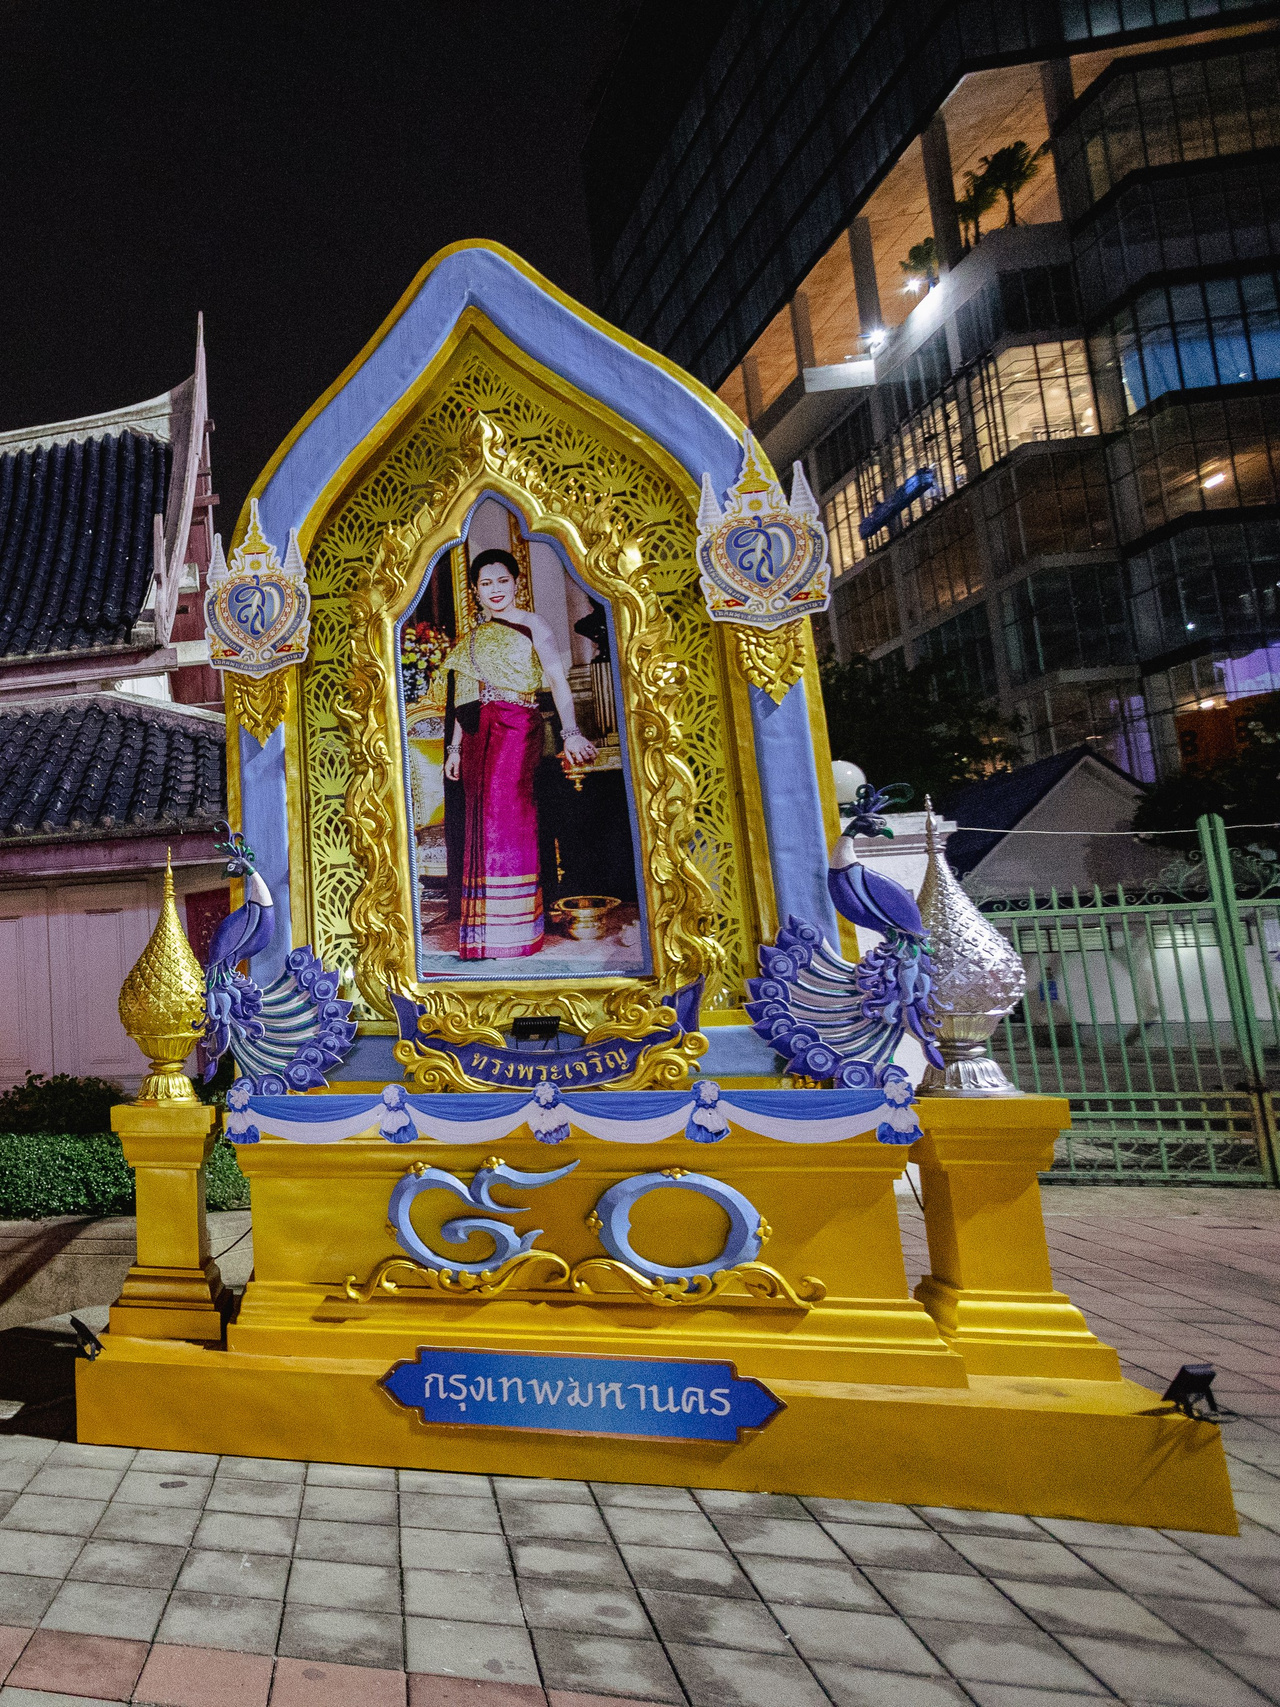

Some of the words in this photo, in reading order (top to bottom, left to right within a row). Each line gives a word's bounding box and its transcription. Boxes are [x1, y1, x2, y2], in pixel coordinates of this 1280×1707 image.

[471, 1047, 629, 1081] ทรงพระเจริญ
[424, 1372, 731, 1416] กรุงเทพมหานคร
